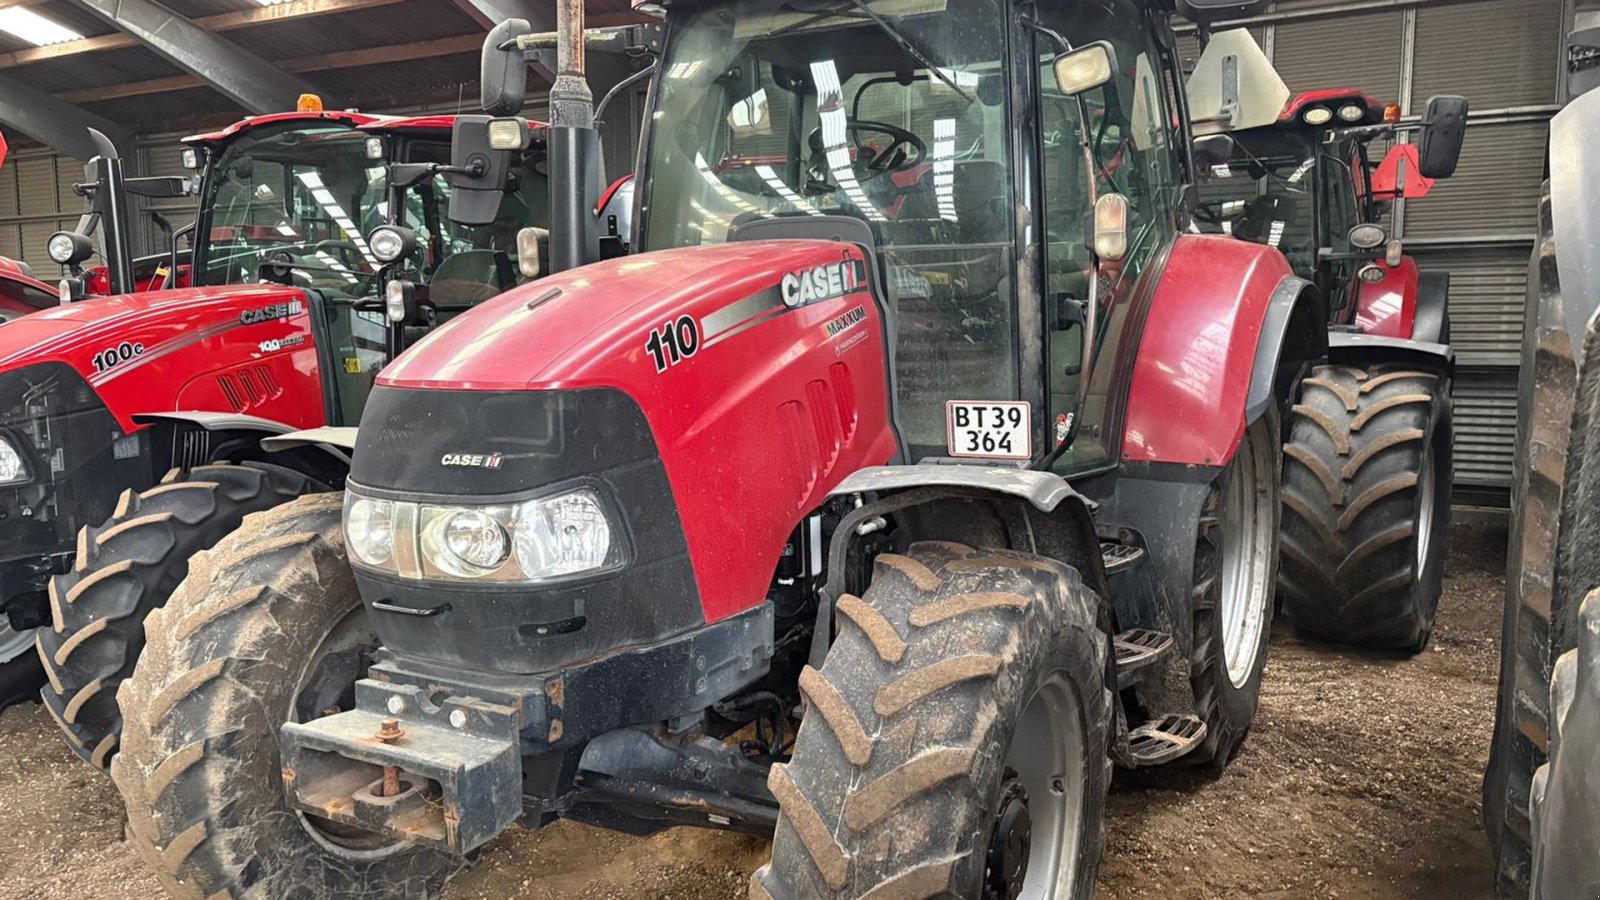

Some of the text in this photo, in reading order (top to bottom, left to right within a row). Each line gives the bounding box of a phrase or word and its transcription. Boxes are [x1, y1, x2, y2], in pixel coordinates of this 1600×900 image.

[780, 263, 841, 308] CASE
[240, 303, 288, 325] CASE
[825, 306, 867, 337] MAXXUM
[258, 339, 281, 352] 100
[644, 314, 699, 374] 110
[966, 430, 1012, 453] 364
[441, 453, 483, 466] CASE
